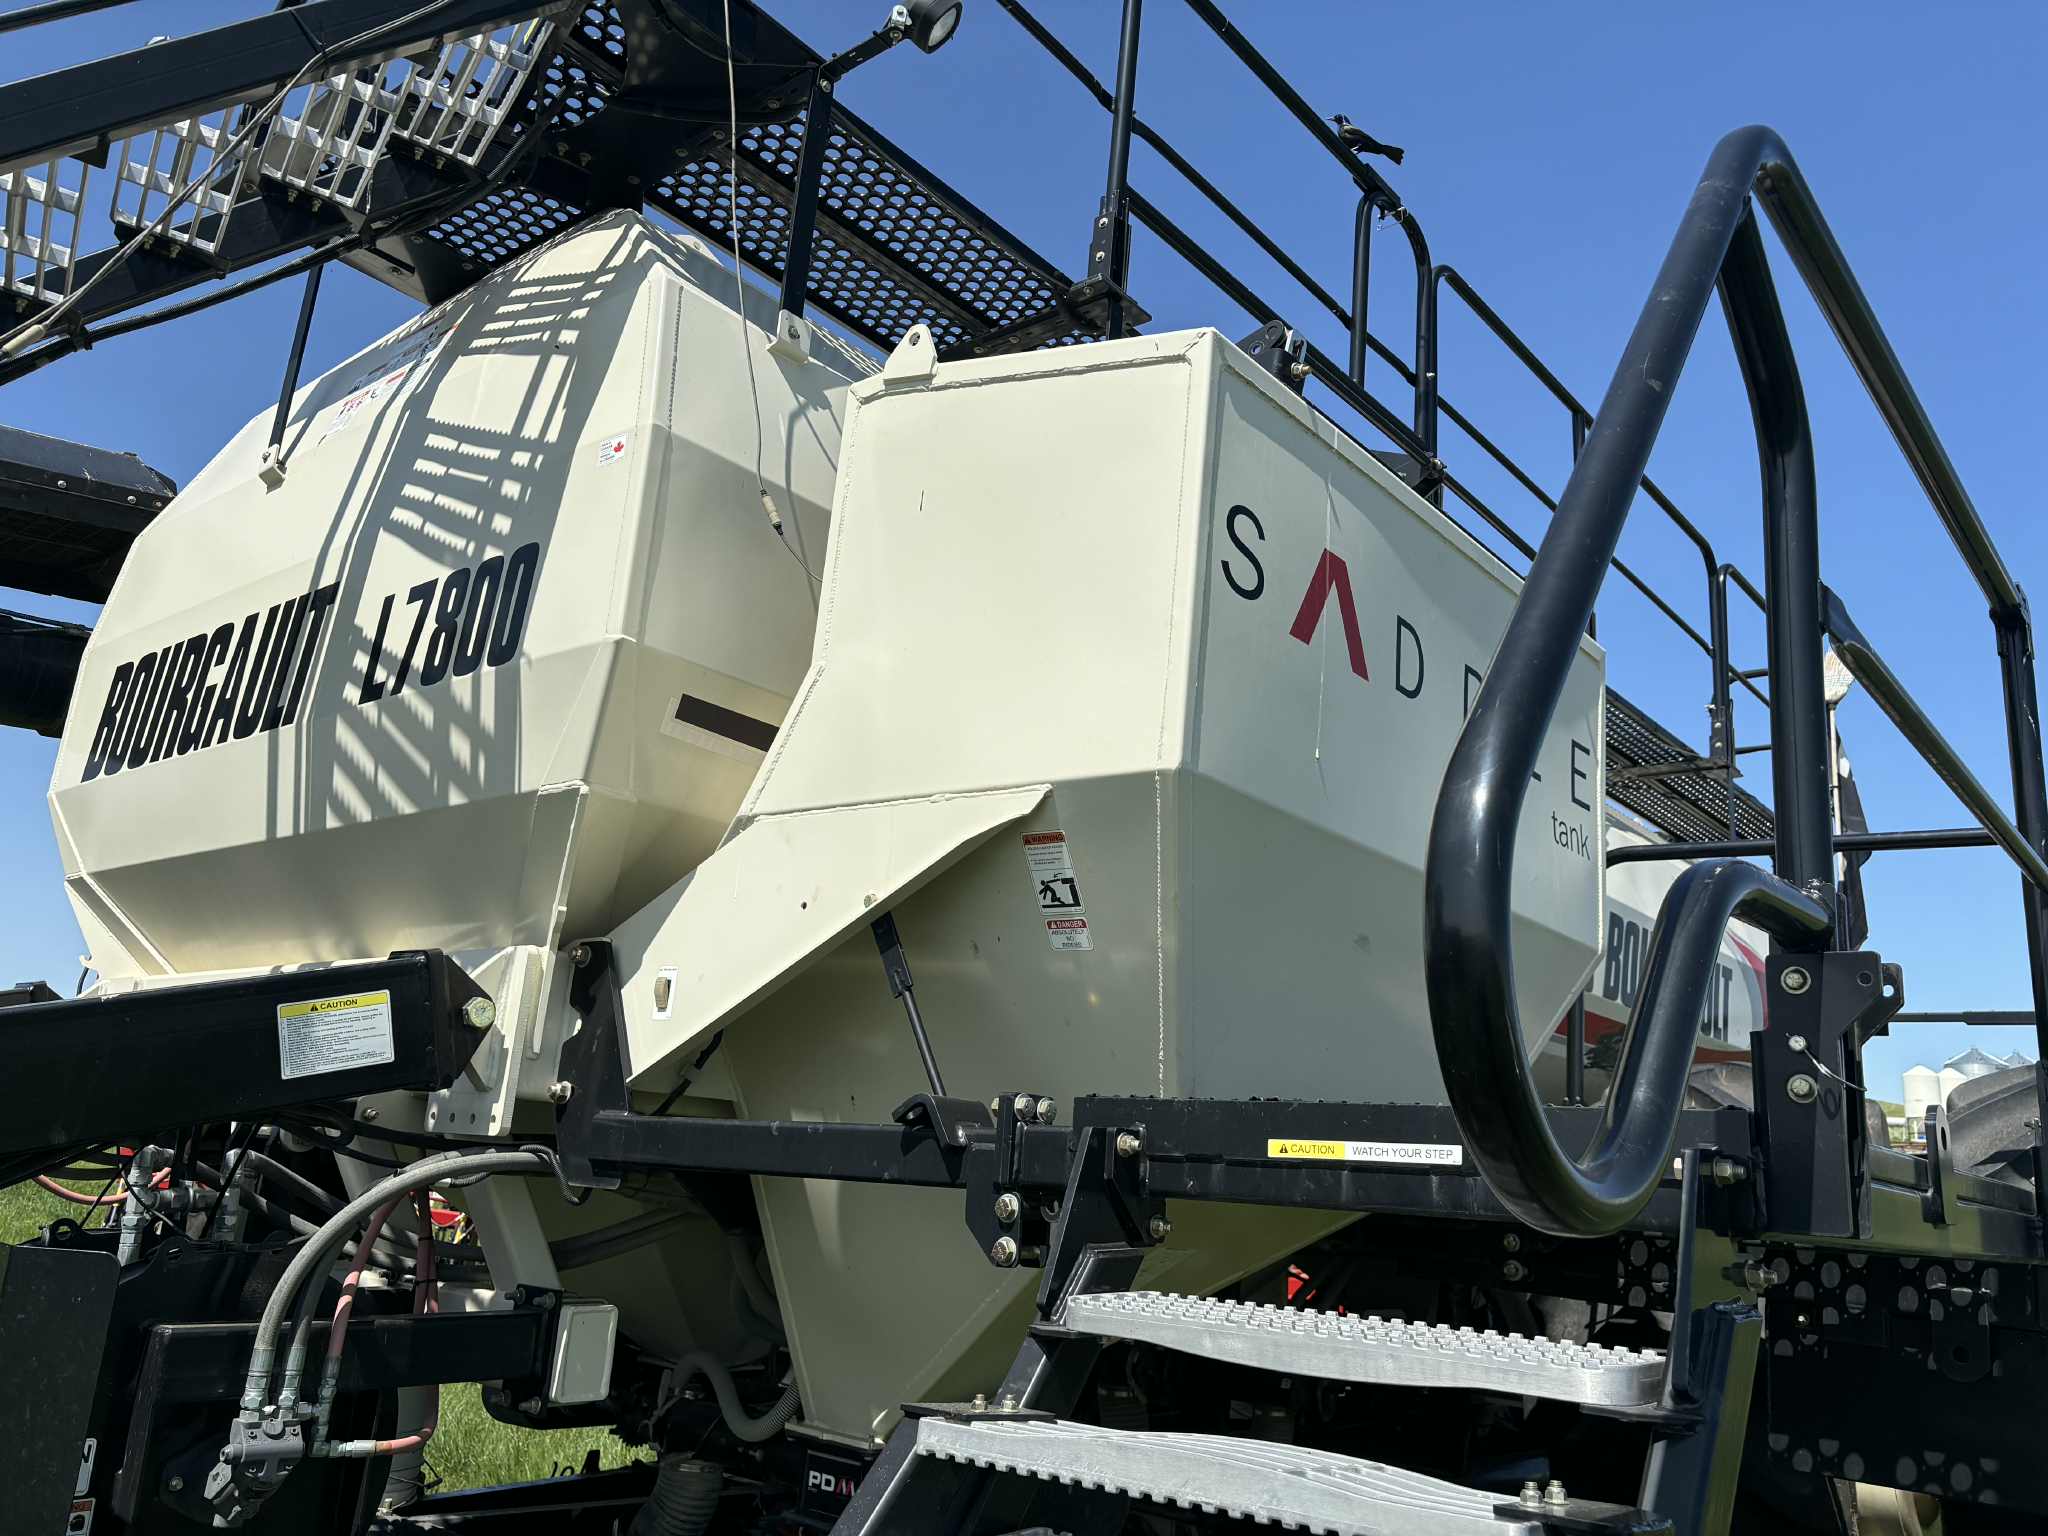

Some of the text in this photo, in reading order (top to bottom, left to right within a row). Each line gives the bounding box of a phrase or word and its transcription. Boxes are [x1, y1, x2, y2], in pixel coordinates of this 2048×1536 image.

[80, 542, 540, 784] BOURGAULT L7800
[1031, 831, 1064, 844] WARNING
[1551, 810, 1591, 861] tank
[1056, 920, 1083, 928] DANGER
[320, 999, 358, 1010] CAUTION
[1290, 1143, 1453, 1160] CAUTION WATCH YOUR STEP
